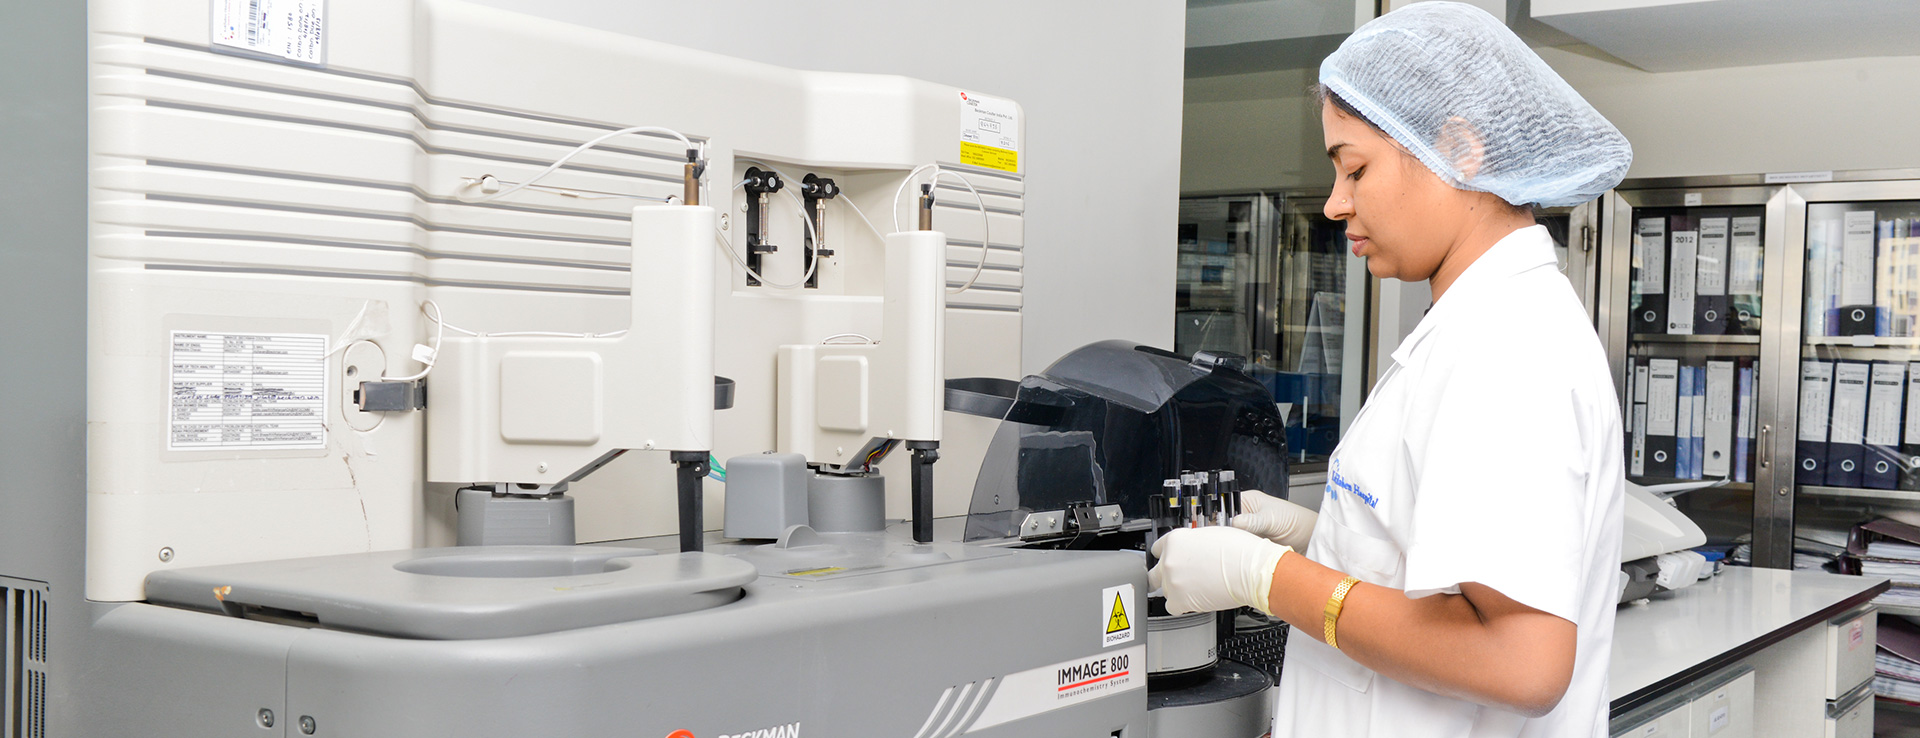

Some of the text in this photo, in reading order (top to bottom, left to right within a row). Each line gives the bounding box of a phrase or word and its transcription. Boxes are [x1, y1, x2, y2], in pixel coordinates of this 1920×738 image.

[1353, 483, 1378, 509] Hospital
[1106, 632, 1130, 642] BIOHAZARD
[1058, 654, 1129, 685] IMMAGE 800
[1058, 678, 1130, 700] Immunochemistry System
